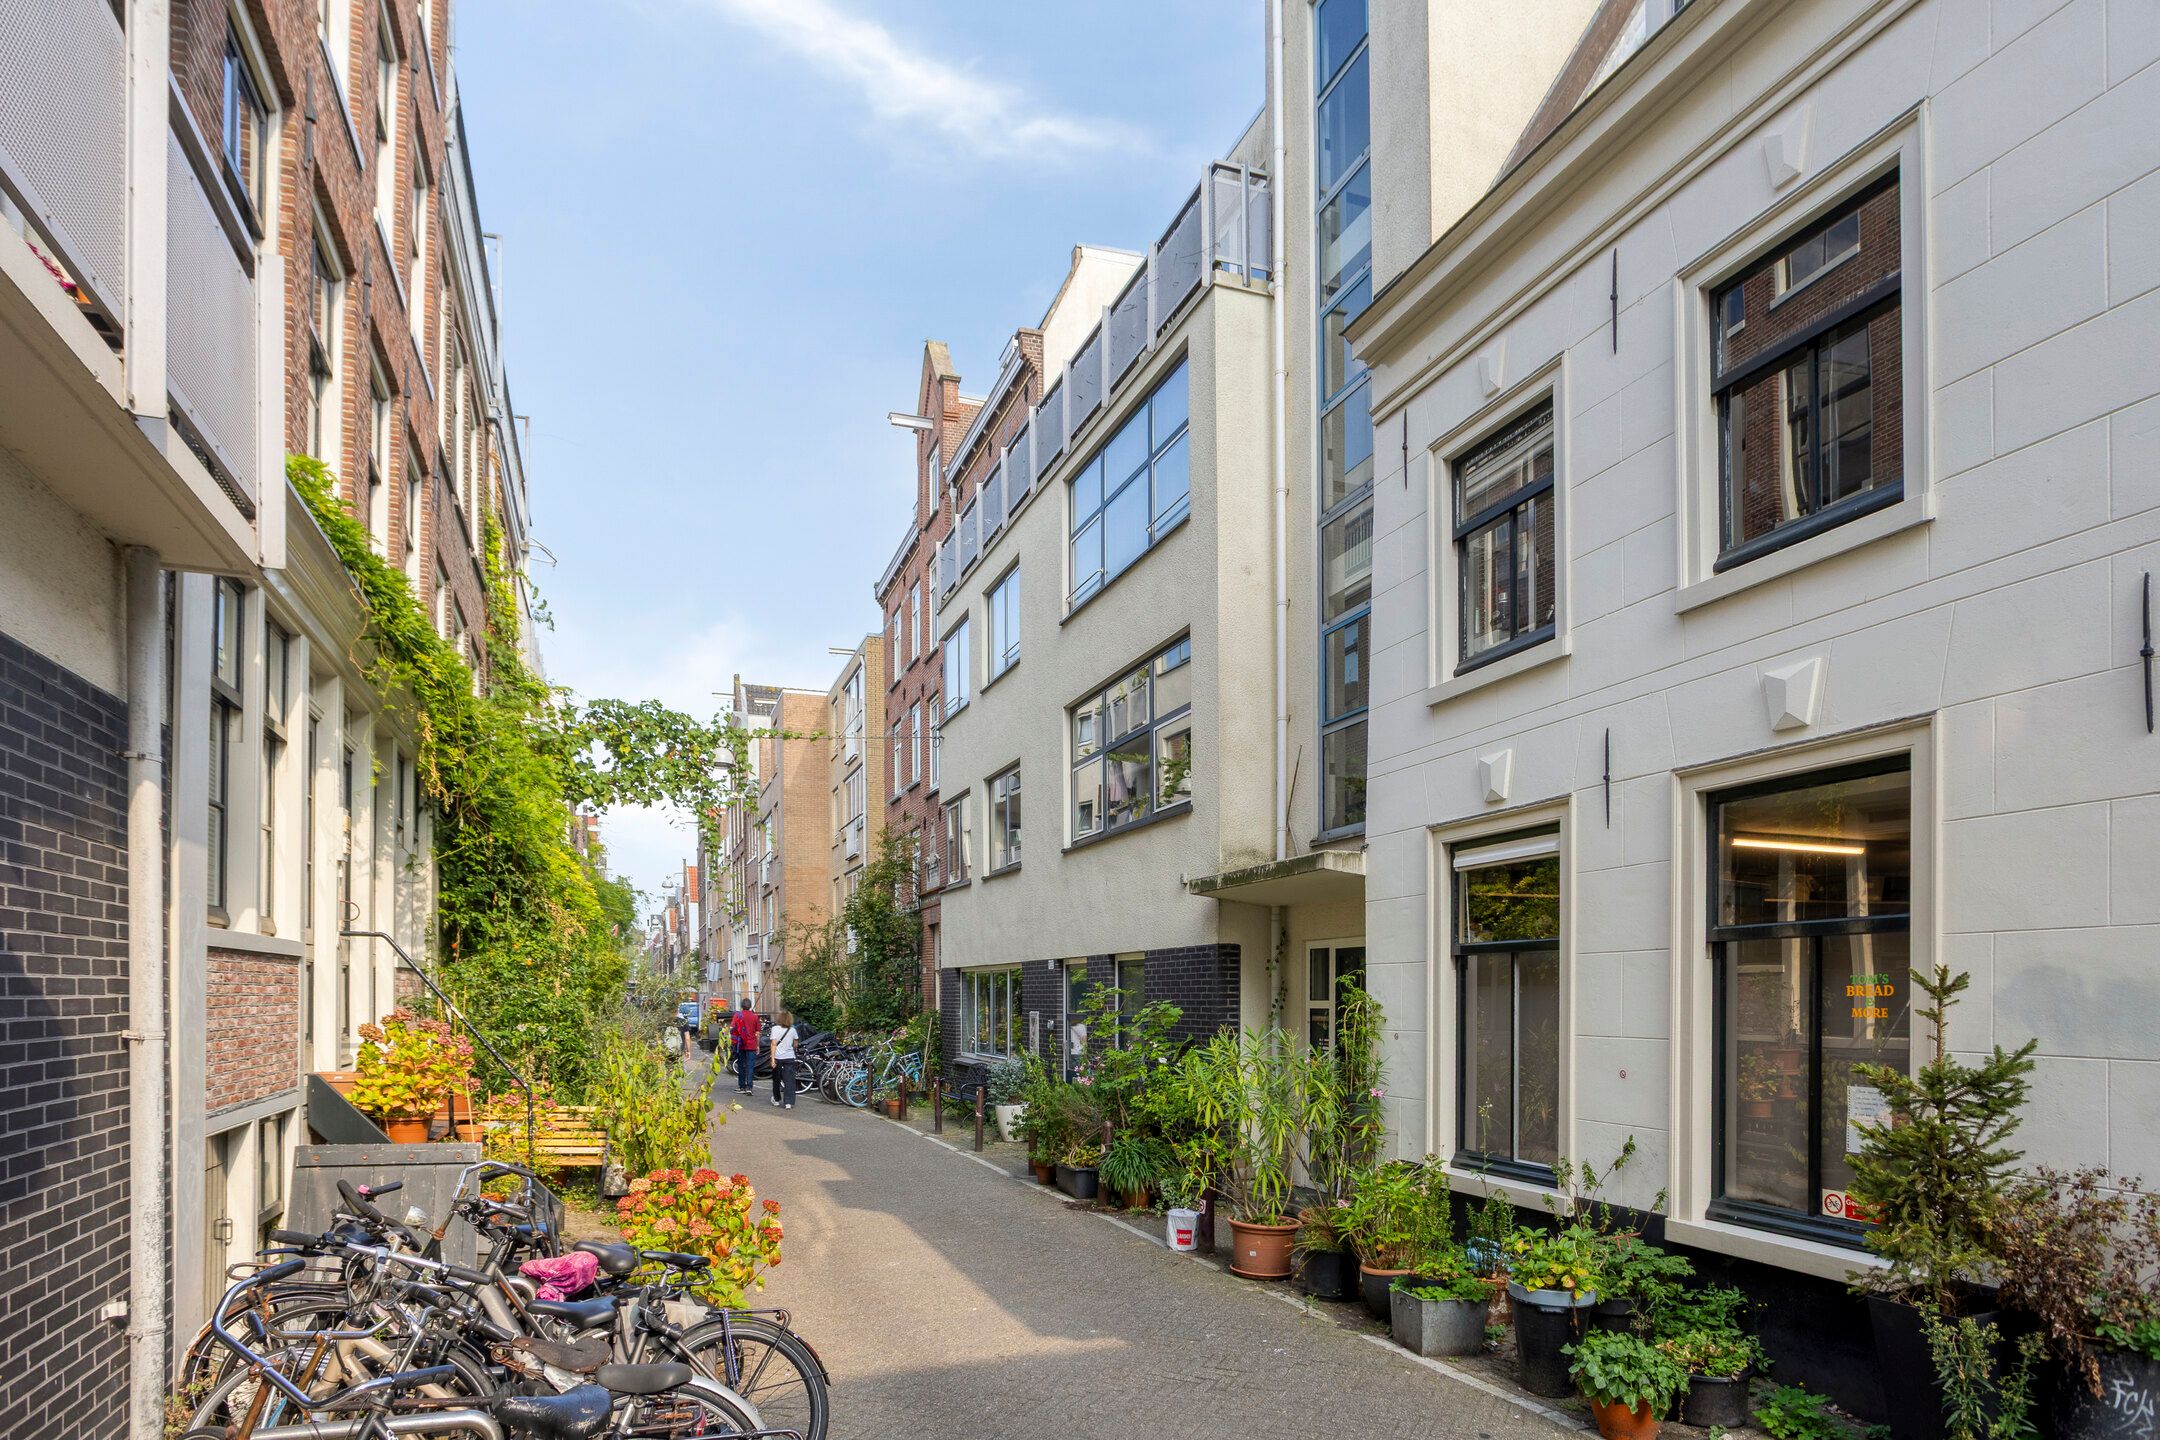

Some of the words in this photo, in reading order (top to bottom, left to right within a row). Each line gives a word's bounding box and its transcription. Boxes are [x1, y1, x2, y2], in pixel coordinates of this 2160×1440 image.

[1850, 973, 1889, 984] TOM'S
[1846, 985, 1894, 997] BREAD
[1851, 1007, 1888, 1018] MORE
